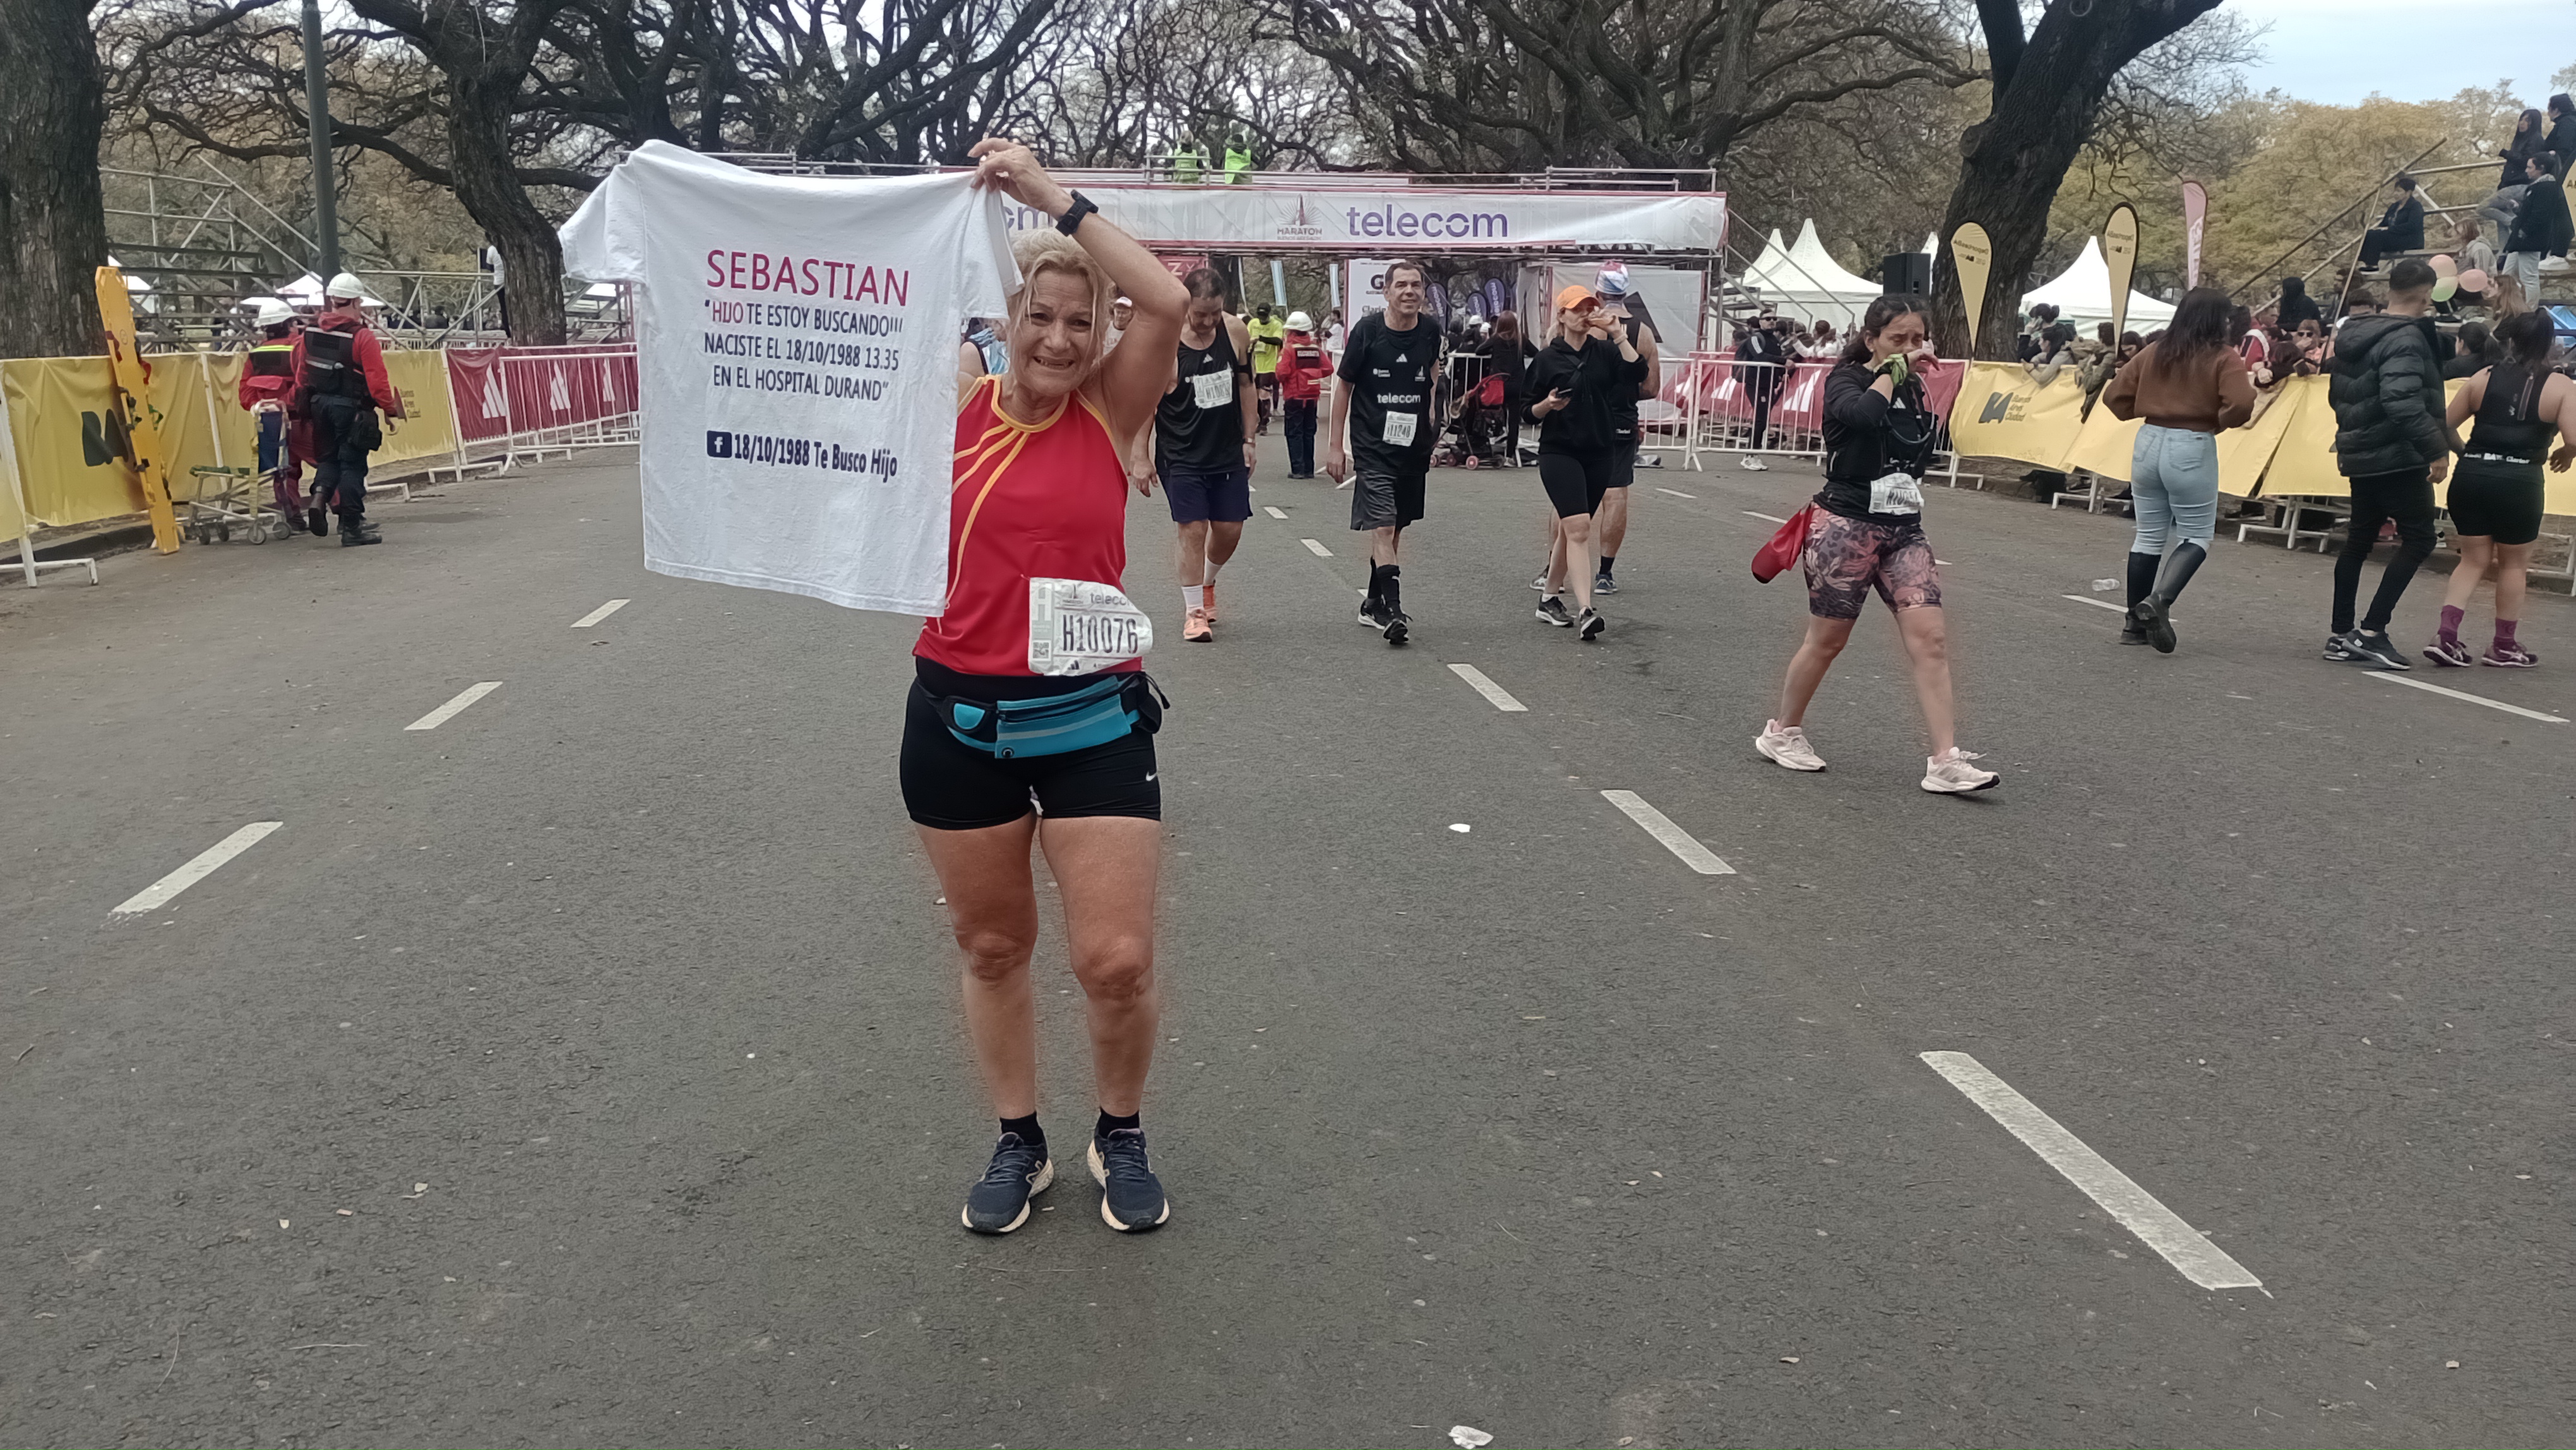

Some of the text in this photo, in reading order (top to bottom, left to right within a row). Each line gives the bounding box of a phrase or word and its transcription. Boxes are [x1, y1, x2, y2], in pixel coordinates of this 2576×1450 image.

[1346, 204, 1508, 237] telecom
[707, 249, 909, 306] SEBASTIAN
[746, 303, 761, 325] TE
[767, 304, 809, 328] ESTOY
[705, 332, 899, 371] NACISTE EL 18/10/1988 13.35
[714, 365, 731, 386] EN
[737, 367, 751, 388] EL
[755, 368, 820, 395] HOSPITAL
[1377, 392, 1421, 404] telecom
[735, 434, 810, 467] 18/10/1988
[814, 441, 828, 469] Te
[832, 444, 867, 473] Busco
[871, 448, 897, 483] Hijo
[1063, 614, 1138, 654] H10076
